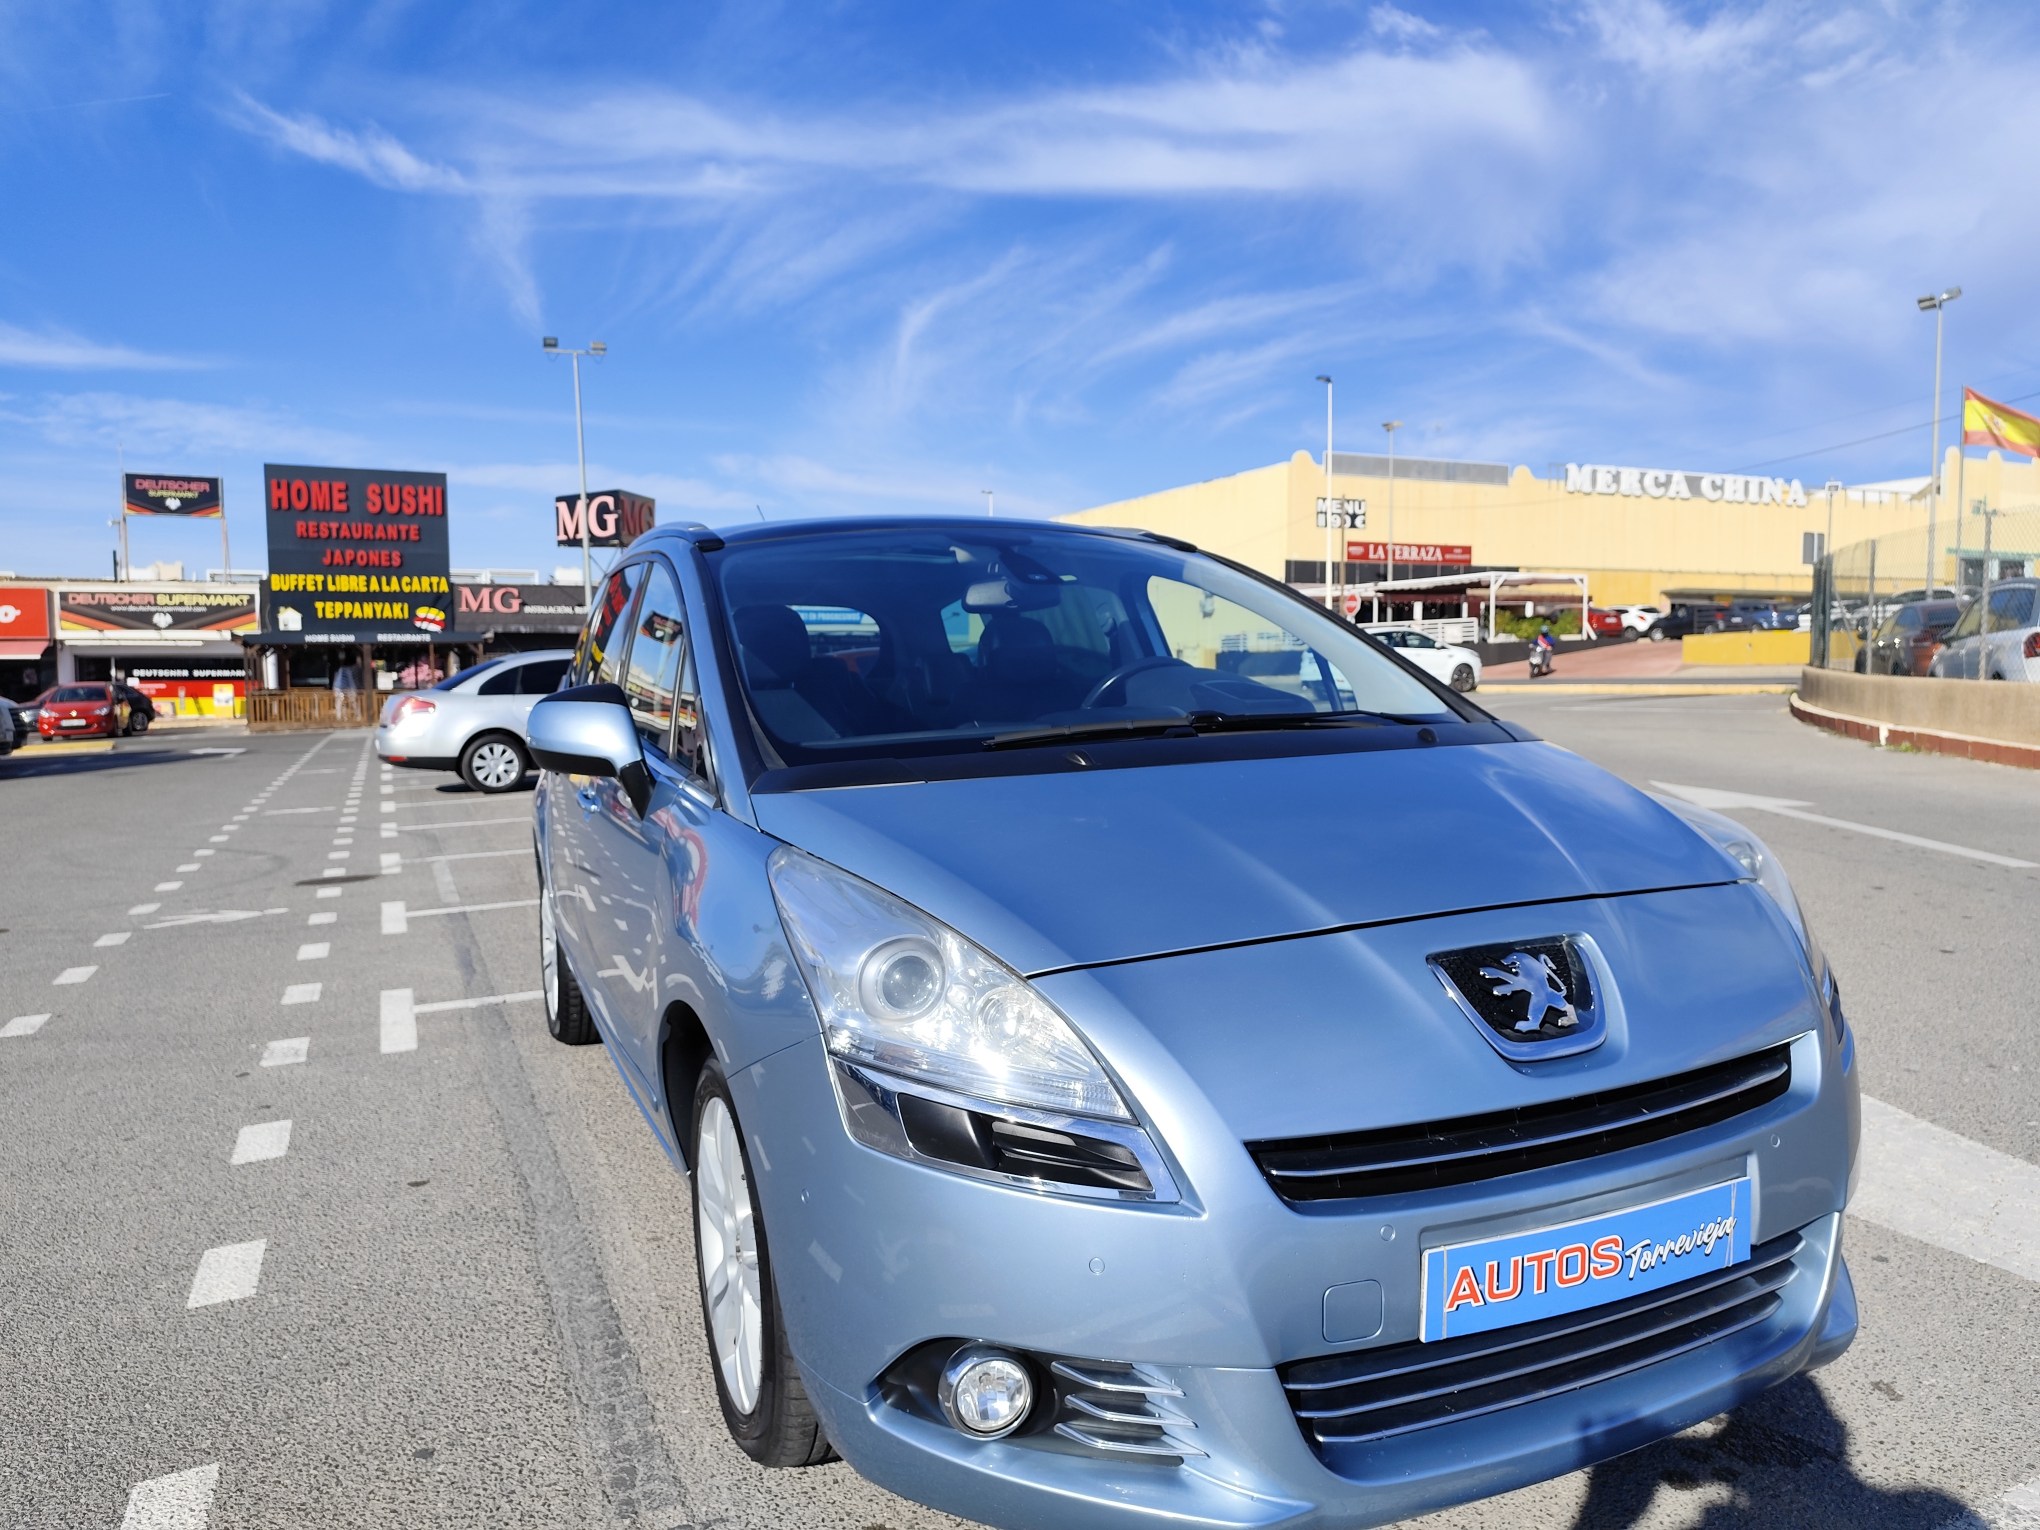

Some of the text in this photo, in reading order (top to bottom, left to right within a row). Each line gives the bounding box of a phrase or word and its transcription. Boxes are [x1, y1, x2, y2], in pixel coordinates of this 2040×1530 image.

[135, 479, 210, 493] DEUTSCHER
[148, 489, 199, 499] SUPERMARKT
[1565, 462, 1808, 507] MERCA CHINA
[270, 478, 443, 515] HOME SUSHI
[555, 495, 618, 541] MG
[295, 521, 420, 542] RESTAURANTE
[322, 548, 402, 568] JAPONES
[1368, 543, 1386, 560] LA
[270, 573, 449, 593] BUFFET LIBRE A LA CARTA
[67, 592, 250, 607] DEUTSCHER SUPERMARKT
[458, 586, 523, 614] MG
[314, 601, 409, 620] TEPPANYAKI
[377, 633, 431, 642] RESTAURANTE
[132, 668, 189, 677] DEUTSCHER
[1446, 1215, 1738, 1313] AUTOS Torrevieja
